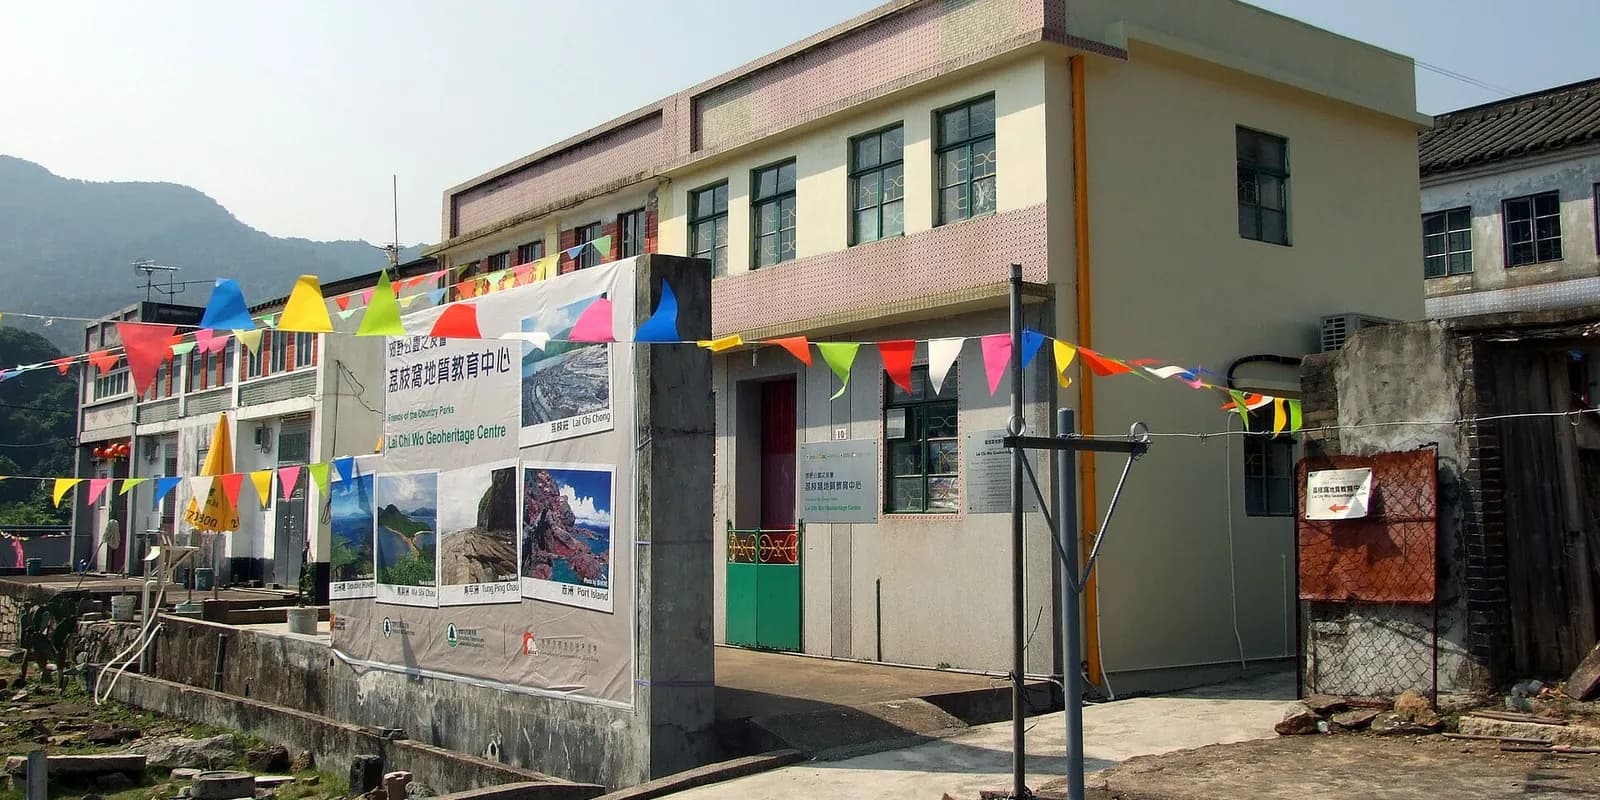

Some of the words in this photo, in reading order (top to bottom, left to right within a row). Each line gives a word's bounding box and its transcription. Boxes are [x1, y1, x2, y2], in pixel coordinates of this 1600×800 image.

[388, 347, 511, 393] 荔枝窩地質教育中心
[404, 410, 410, 420] of
[418, 406, 438, 418] Country
[439, 404, 455, 415] Parks
[572, 416, 581, 428] Lai
[581, 414, 592, 426] Chi
[592, 412, 611, 423] Chong
[388, 434, 398, 449] Lai
[399, 433, 411, 448] Chi
[411, 431, 425, 446] Wo
[426, 427, 475, 445] Geoheritage
[477, 423, 506, 439] Centre
[577, 586, 590, 598] Port
[590, 589, 609, 601] Island
